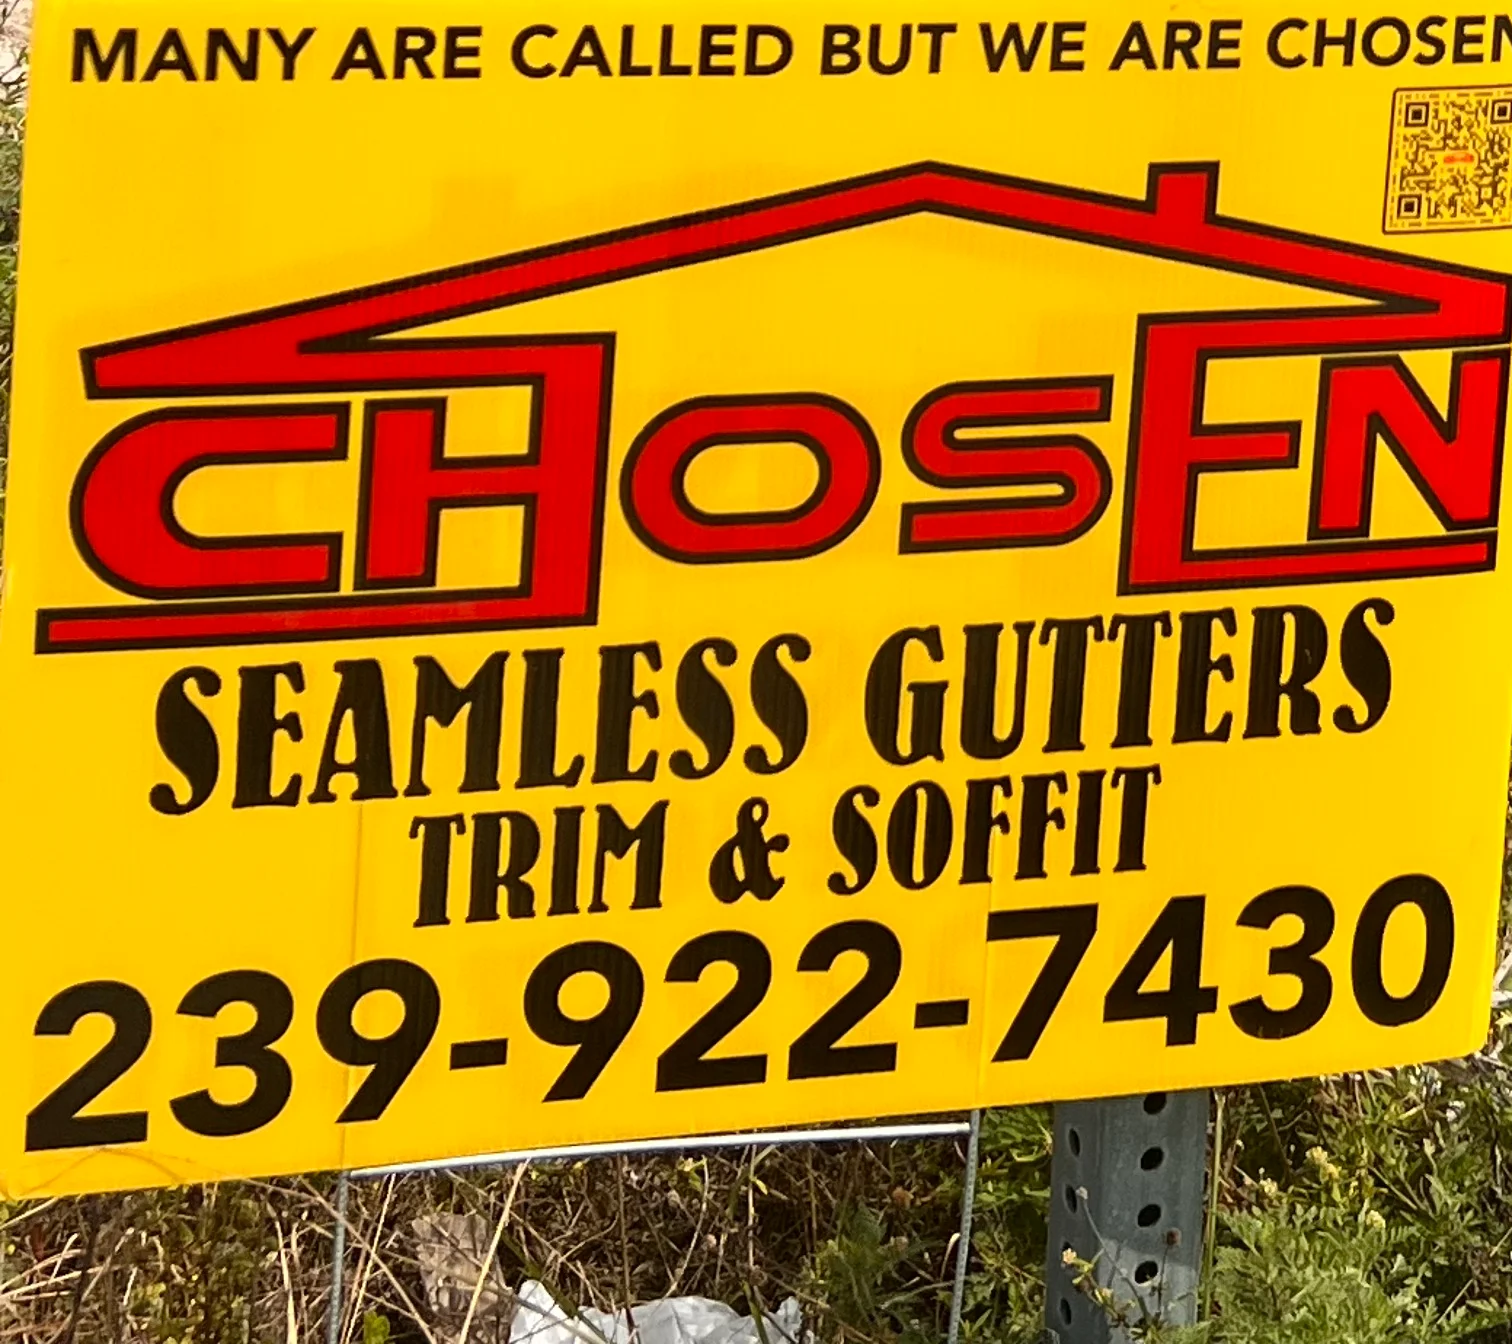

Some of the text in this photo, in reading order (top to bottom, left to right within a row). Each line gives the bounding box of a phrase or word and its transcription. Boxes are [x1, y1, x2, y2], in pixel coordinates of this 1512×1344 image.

[73, 29, 314, 81] MANY
[333, 27, 481, 79] ARE
[512, 26, 792, 78] CALLED
[822, 24, 956, 75] BUT
[980, 23, 1085, 72] WE
[1110, 21, 1241, 70] ARE
[35, 311, 1512, 655] CHOSEN
[149, 599, 1394, 815] SEAMLESS GUTTERS
[410, 765, 1161, 927] TRIM & SOFFIT
[25, 873, 1455, 1153] 239-922-7430
